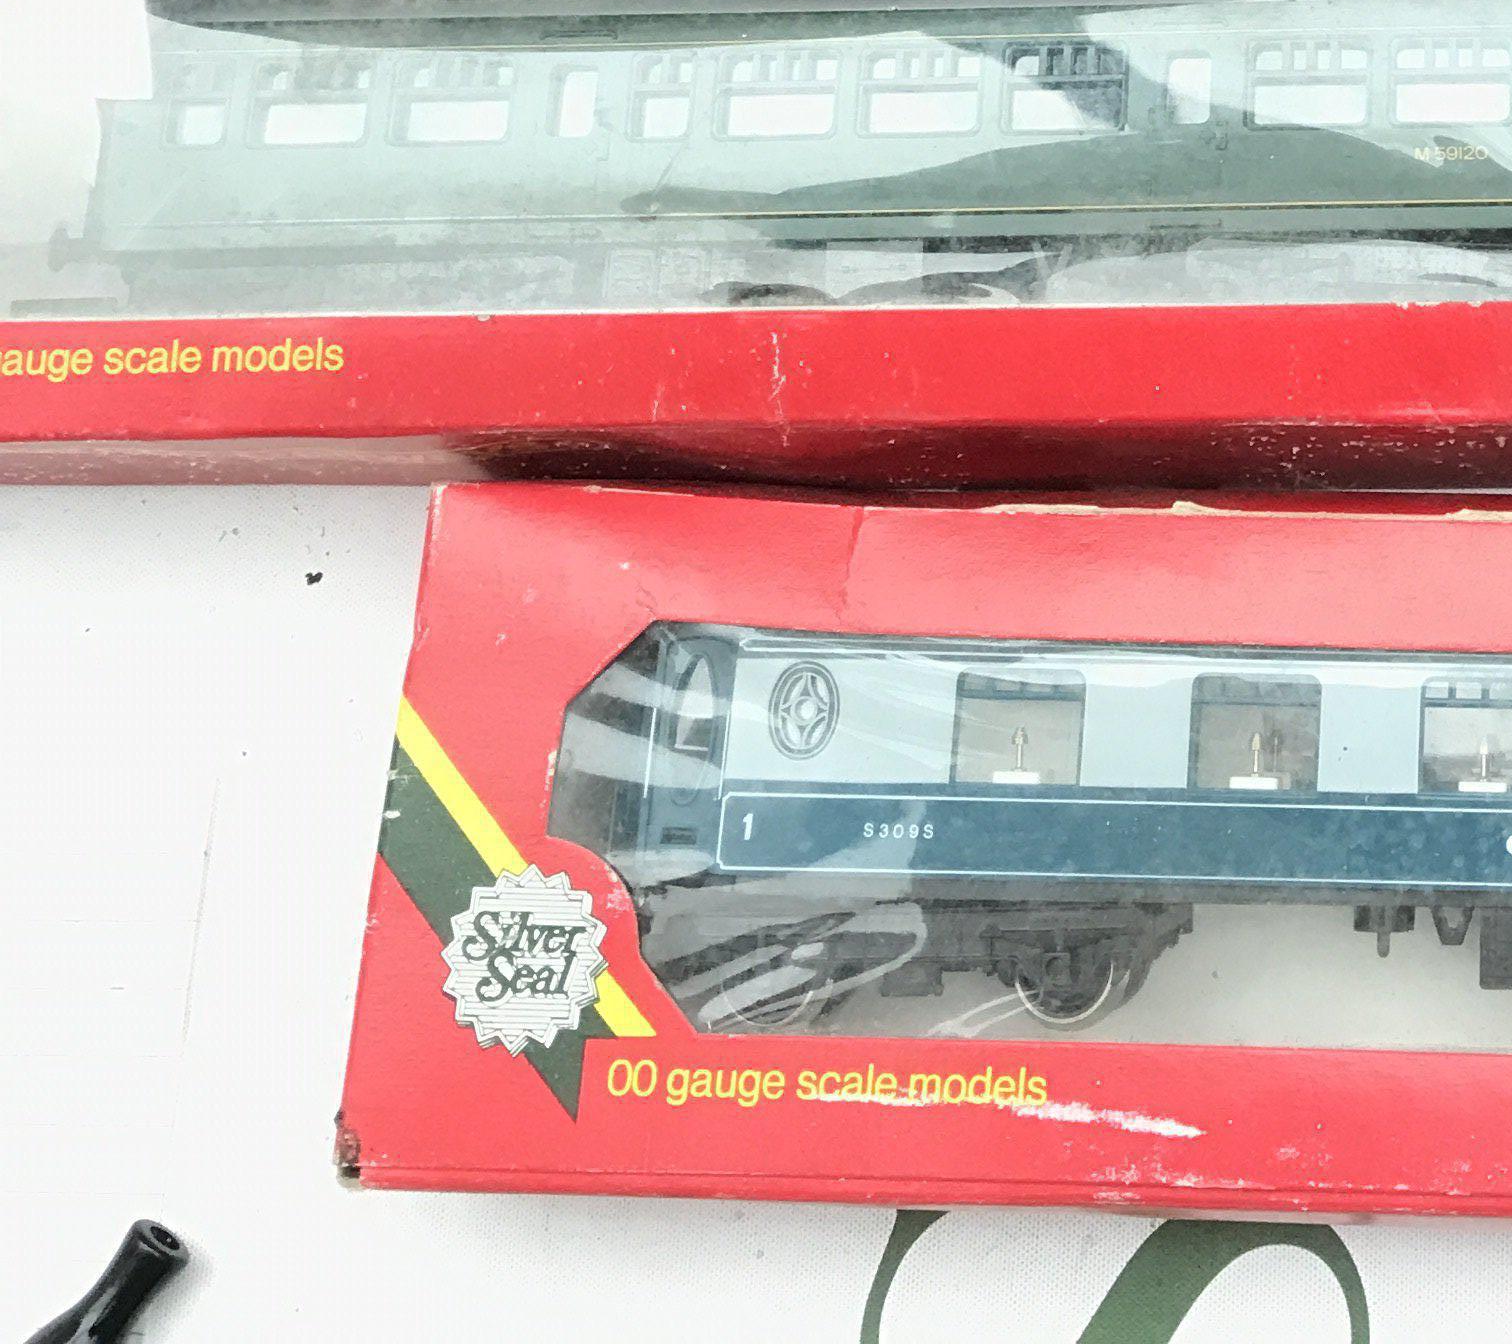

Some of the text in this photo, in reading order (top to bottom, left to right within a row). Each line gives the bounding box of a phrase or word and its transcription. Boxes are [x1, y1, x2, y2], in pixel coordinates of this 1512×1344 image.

[0, 336, 345, 383] auge scale models
[741, 812, 755, 842] 1
[862, 822, 935, 840] S309S
[462, 910, 585, 962] Silver
[475, 949, 574, 1003] Seal
[666, 1065, 786, 1108] gauge
[795, 1063, 897, 1103] scale
[907, 1065, 1049, 1108] models
